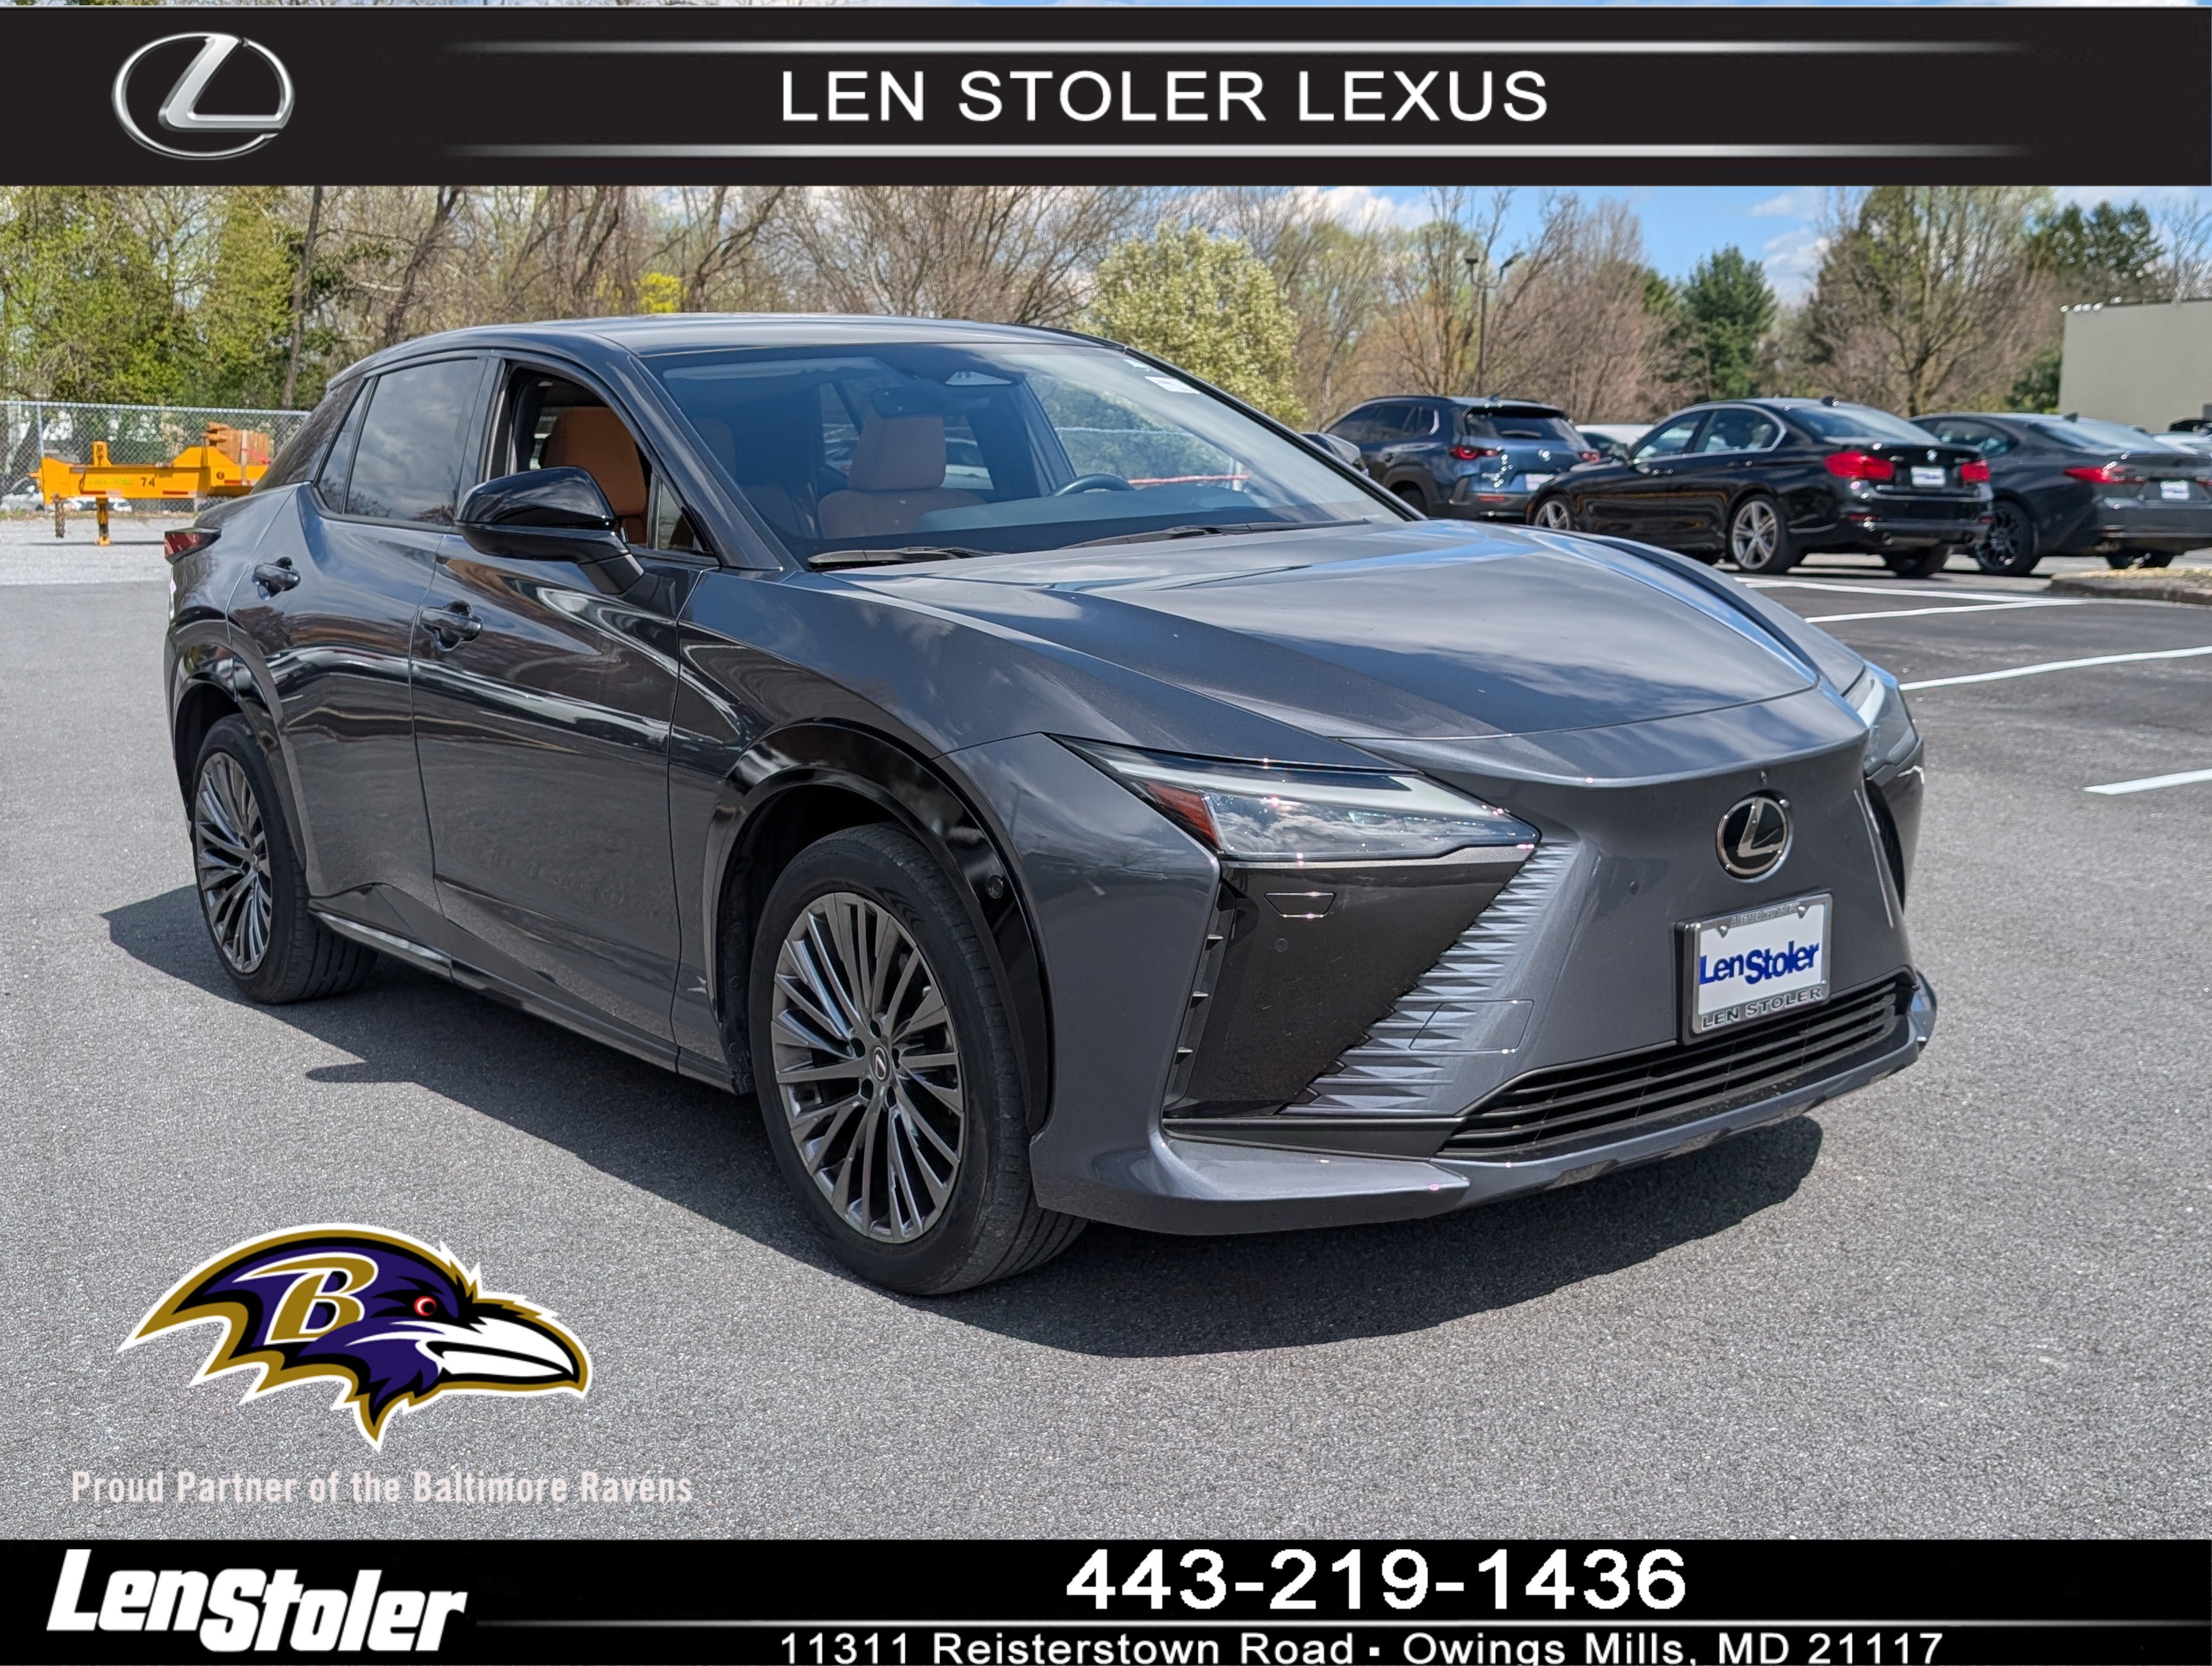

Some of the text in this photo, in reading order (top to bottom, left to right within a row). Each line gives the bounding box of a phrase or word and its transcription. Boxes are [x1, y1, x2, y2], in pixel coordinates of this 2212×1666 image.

[140, 477, 156, 487] 74
[1699, 940, 1819, 985] LenStoler
[1701, 987, 1823, 1031] LEN STOLER
